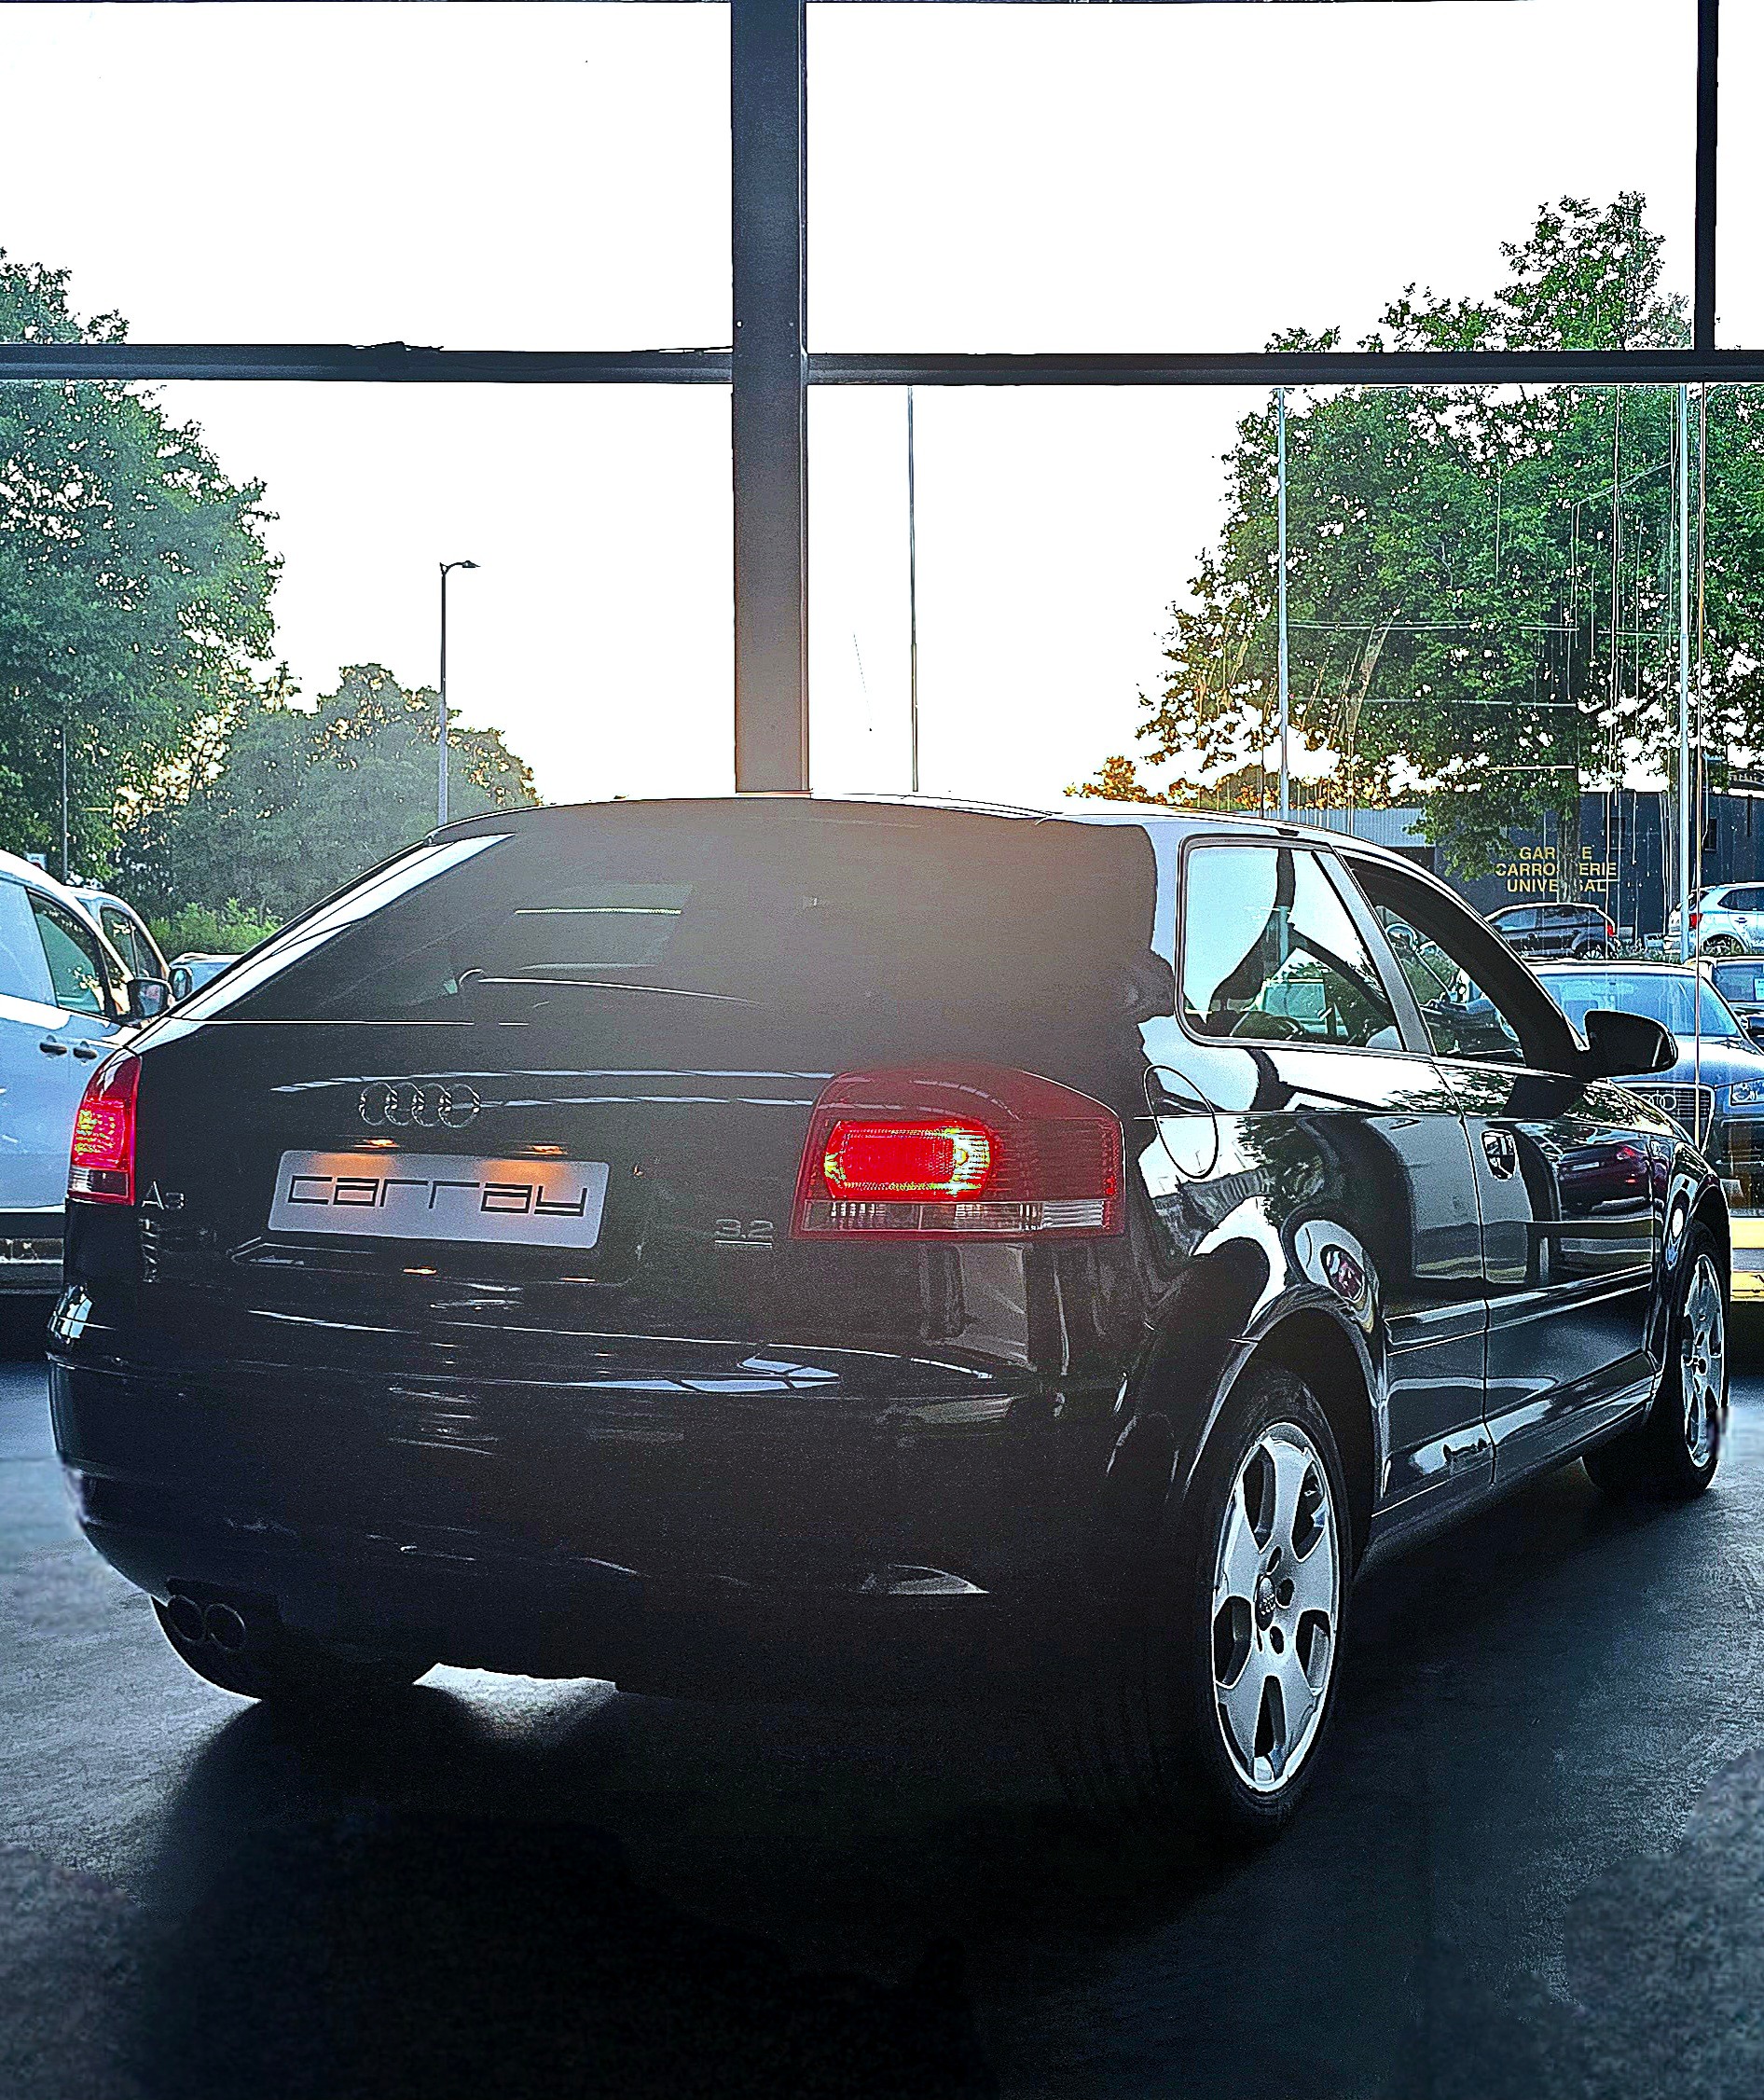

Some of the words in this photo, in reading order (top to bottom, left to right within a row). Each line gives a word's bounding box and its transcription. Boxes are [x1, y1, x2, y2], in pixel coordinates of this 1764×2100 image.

[1520, 846, 1592, 860] GARE
[1495, 862, 1617, 877] CARROERIE
[1507, 878, 1607, 892] UNIVEAL
[714, 1218, 774, 1240] 3.2
